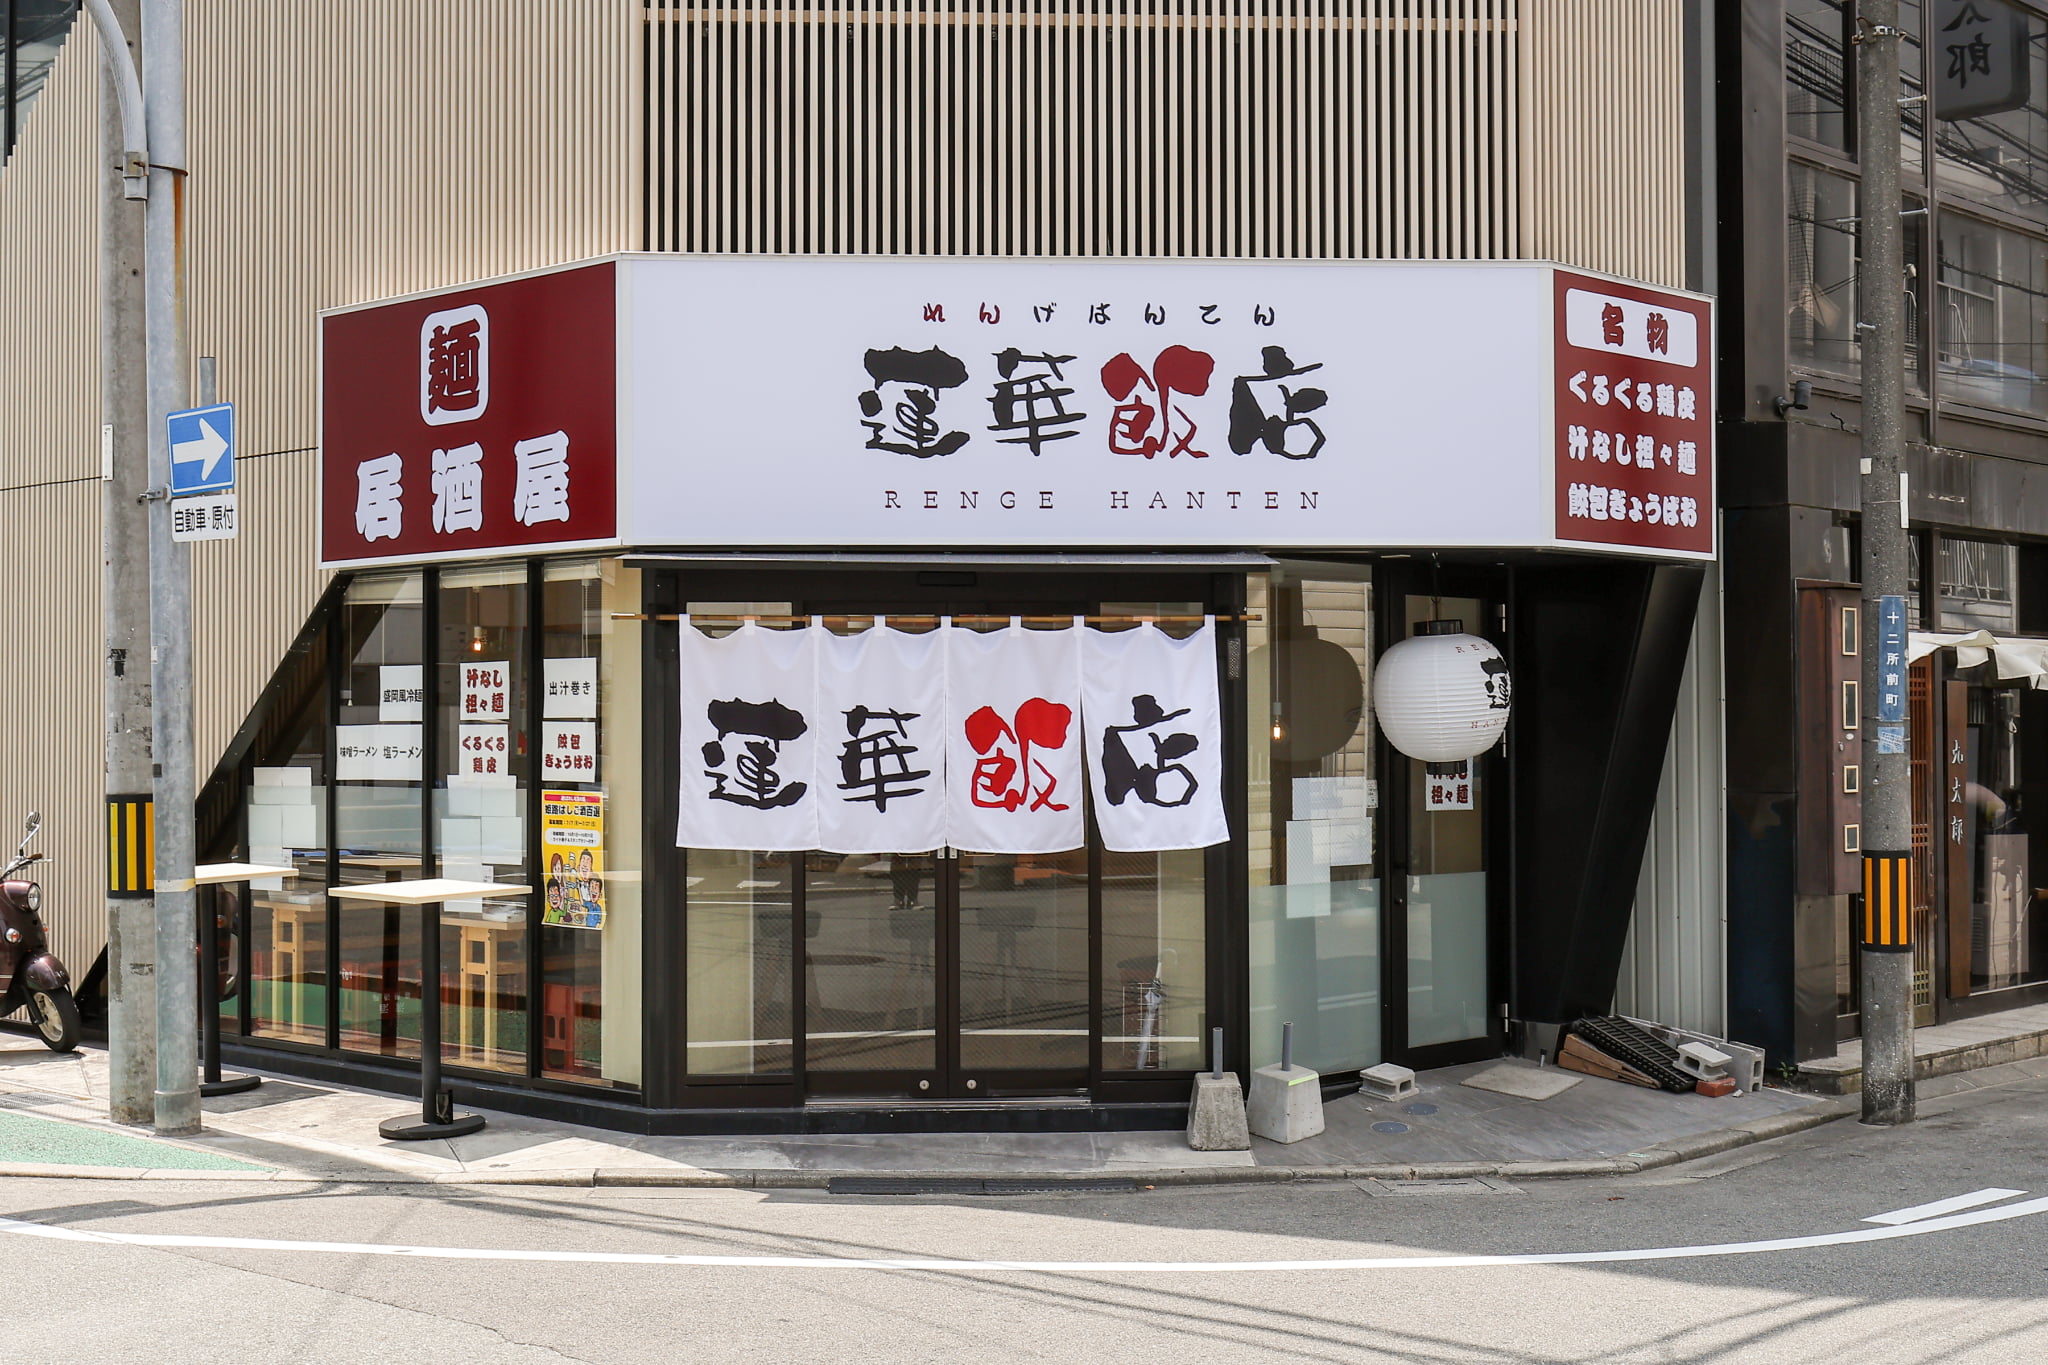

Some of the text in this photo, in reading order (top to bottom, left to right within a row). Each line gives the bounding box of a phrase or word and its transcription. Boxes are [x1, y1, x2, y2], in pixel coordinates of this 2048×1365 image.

[1601, 302, 1669, 355] 名物
[427, 318, 482, 414] 麺
[858, 345, 1328, 460] 蓮華飯店
[1569, 370, 1697, 421] ぐるぐる鶏皮
[1569, 424, 1697, 476] 汁なし担々麺
[355, 430, 571, 544] 居酒屋
[885, 490, 1319, 509] RENGE HANTEN
[174, 505, 234, 533] 自動車・原付
[467, 669, 503, 689] 汁なし
[1885, 611, 1900, 707] 十二所前町
[466, 693, 504, 714] 担々麺
[549, 680, 591, 696] 出汁巻き
[339, 746, 424, 759] 味噌ラーメン 塩ラーメン
[462, 735, 506, 752] ぐるぐる
[702, 695, 1198, 812] 蓮華飯店
